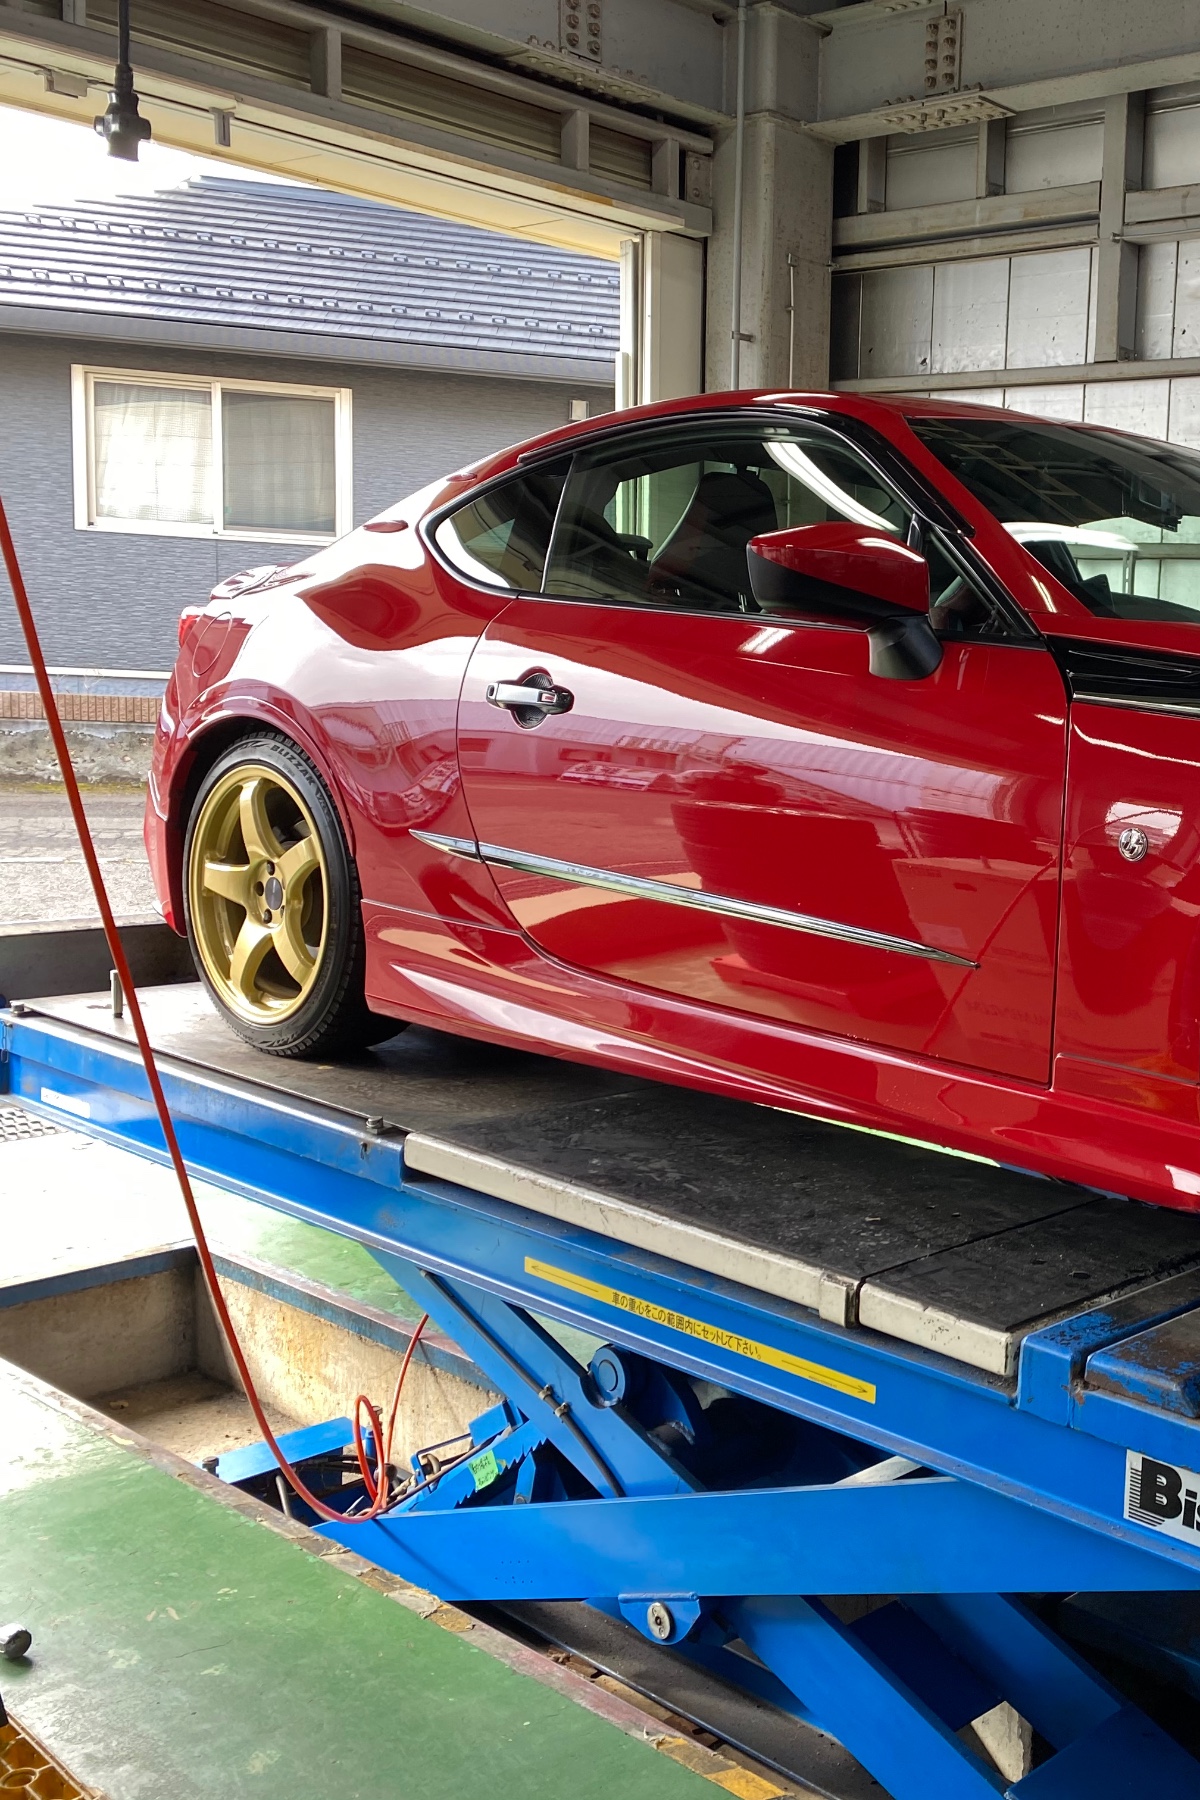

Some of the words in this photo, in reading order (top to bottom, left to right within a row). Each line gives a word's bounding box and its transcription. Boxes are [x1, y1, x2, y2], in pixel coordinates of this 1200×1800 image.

[270, 744, 316, 787] BLIZZAK
[612, 1291, 762, 1360] 車の重心をこの範囲内にセットして下さい。
